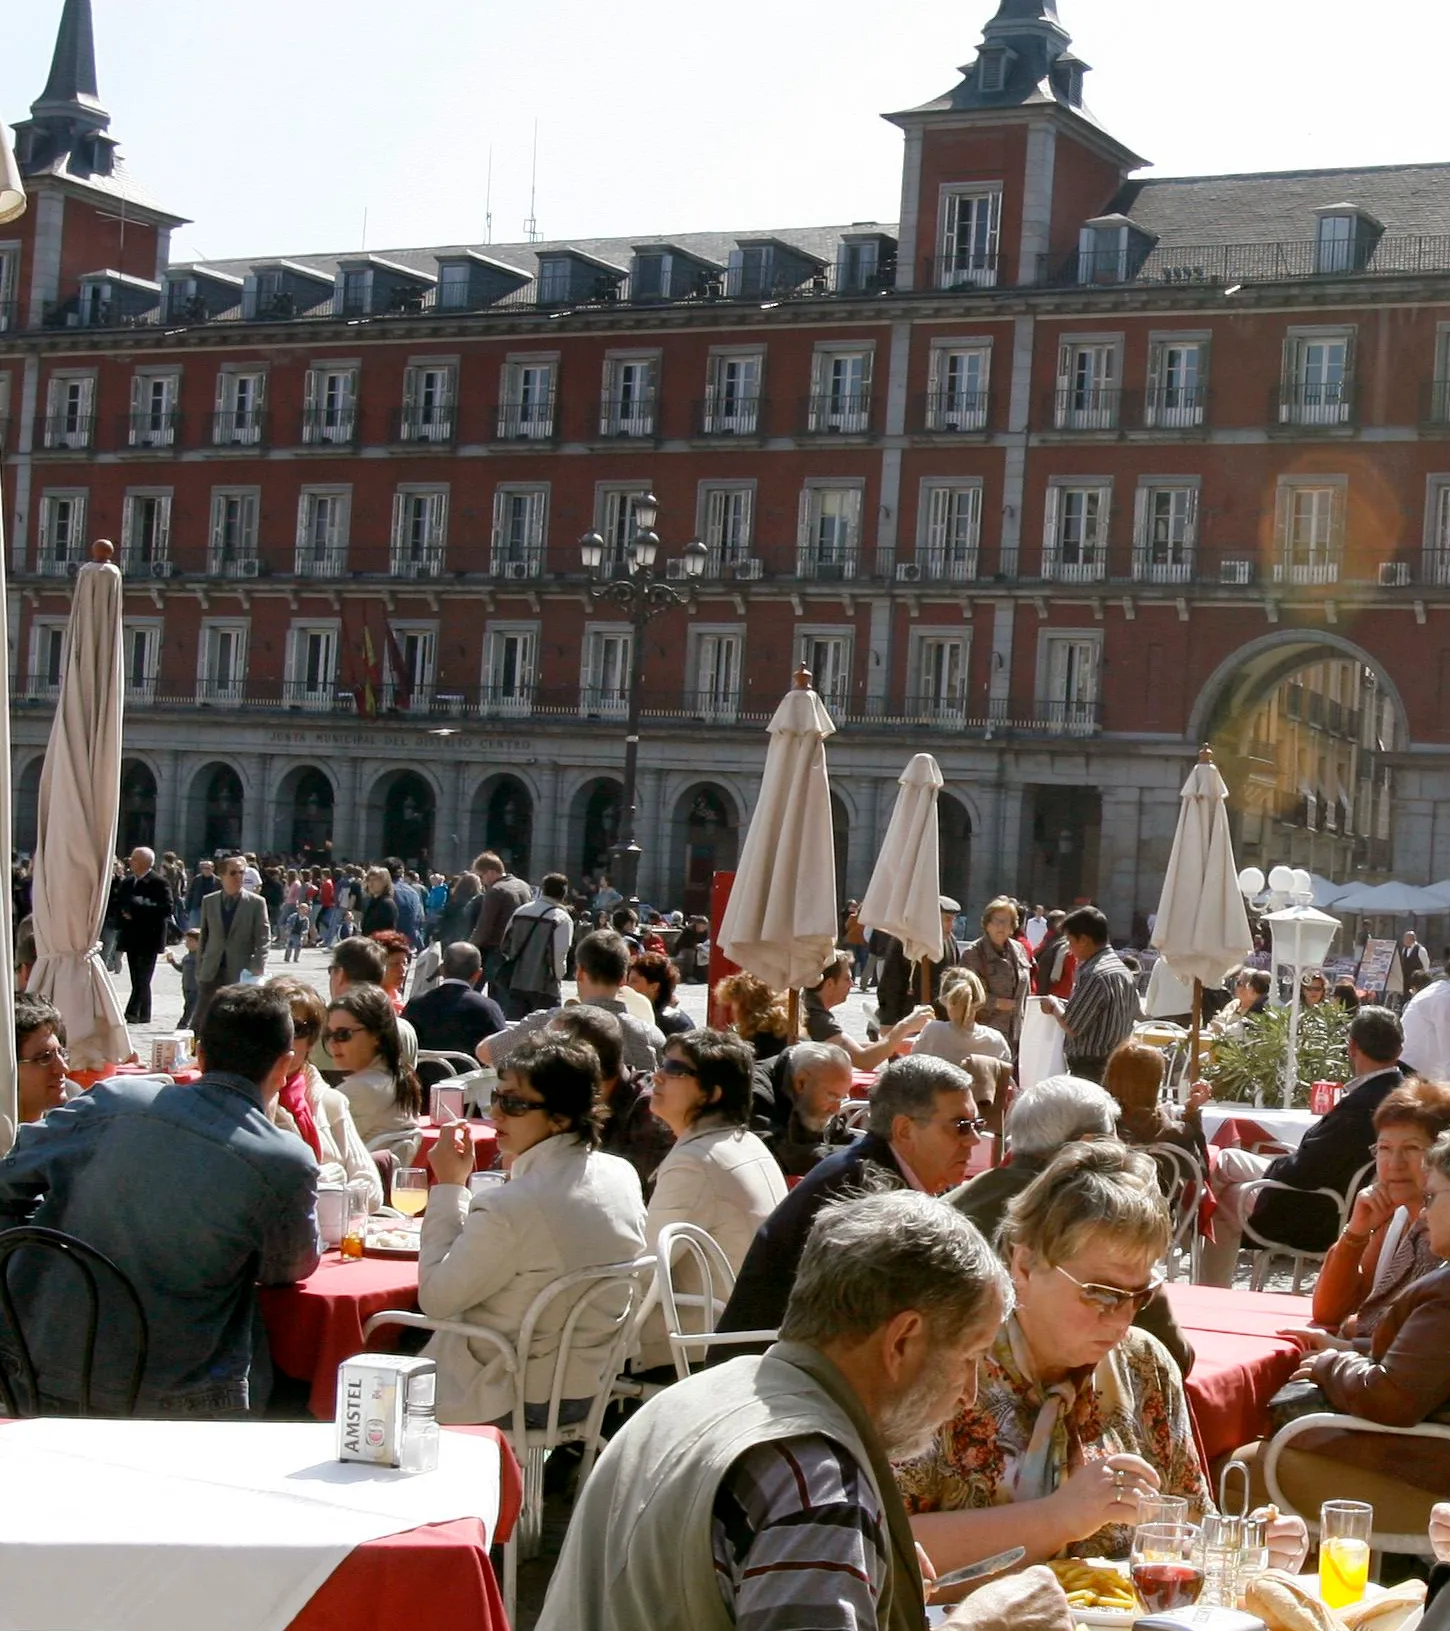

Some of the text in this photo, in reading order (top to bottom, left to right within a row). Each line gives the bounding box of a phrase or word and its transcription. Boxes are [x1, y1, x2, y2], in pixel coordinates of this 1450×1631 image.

[269, 732, 531, 750] JUNTA MUNICIPAL DEL DISTRITO CENTRO
[344, 1379, 362, 1453] AMSTEL
